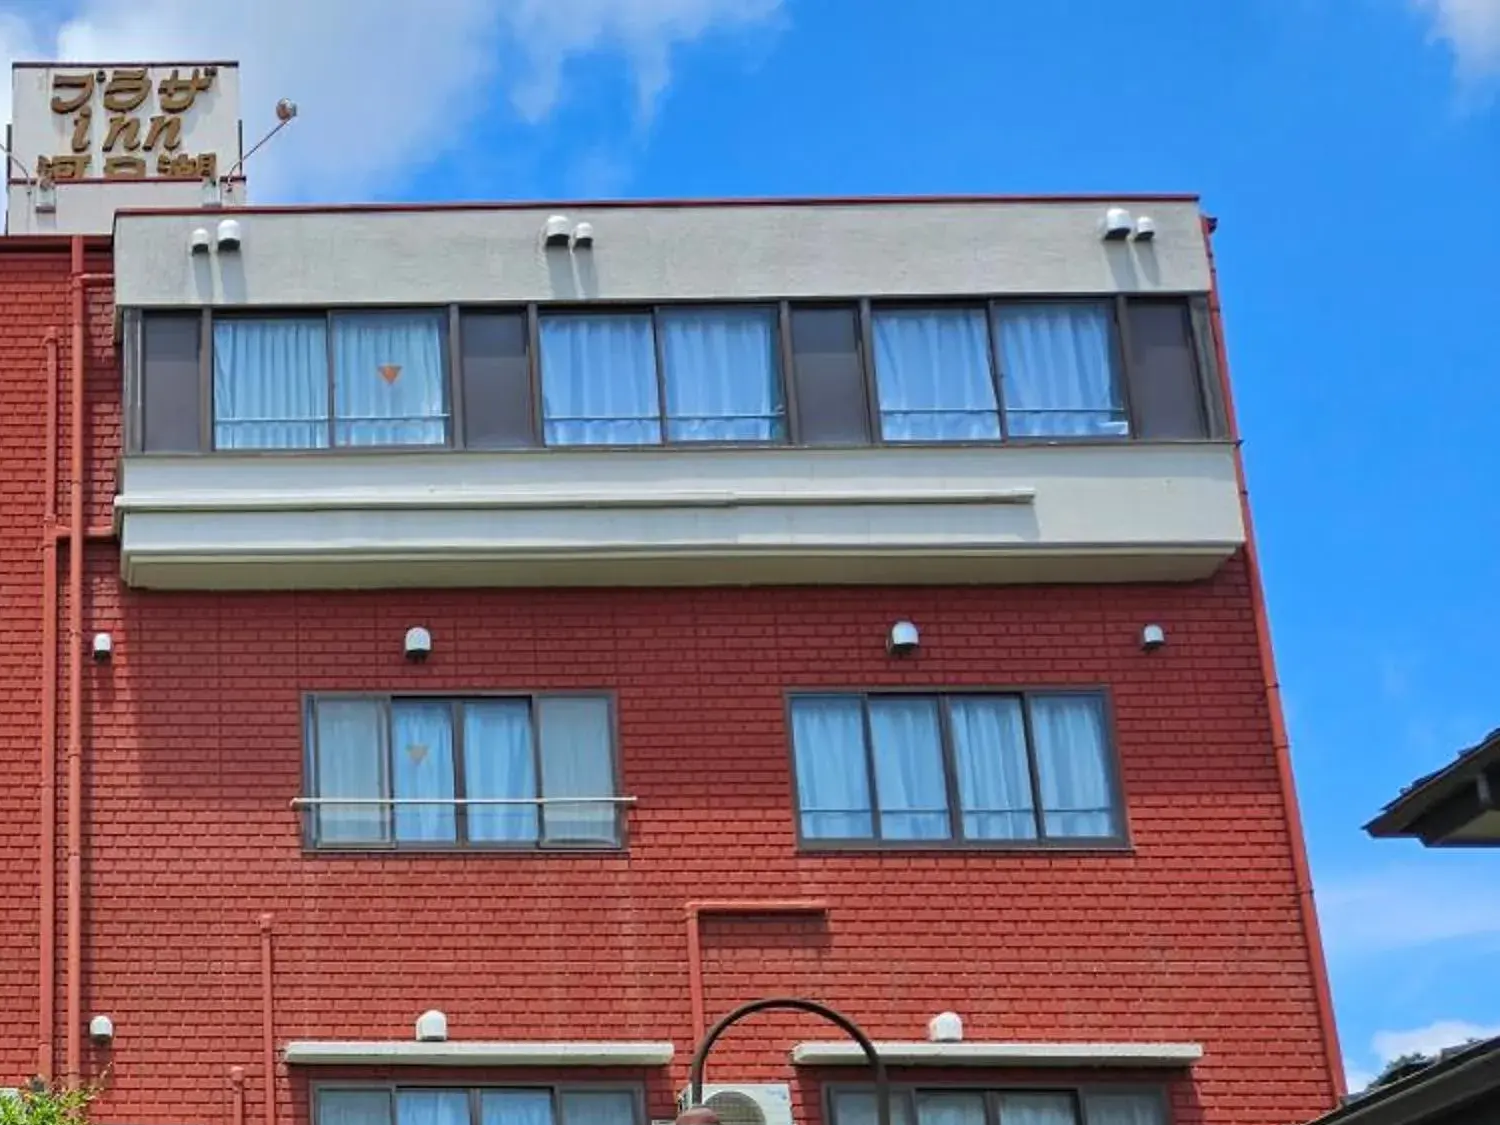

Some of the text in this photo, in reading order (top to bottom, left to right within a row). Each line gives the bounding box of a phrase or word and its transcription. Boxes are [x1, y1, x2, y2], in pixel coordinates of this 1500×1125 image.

[51, 68, 217, 114] プラザ
[71, 105, 183, 152] inn
